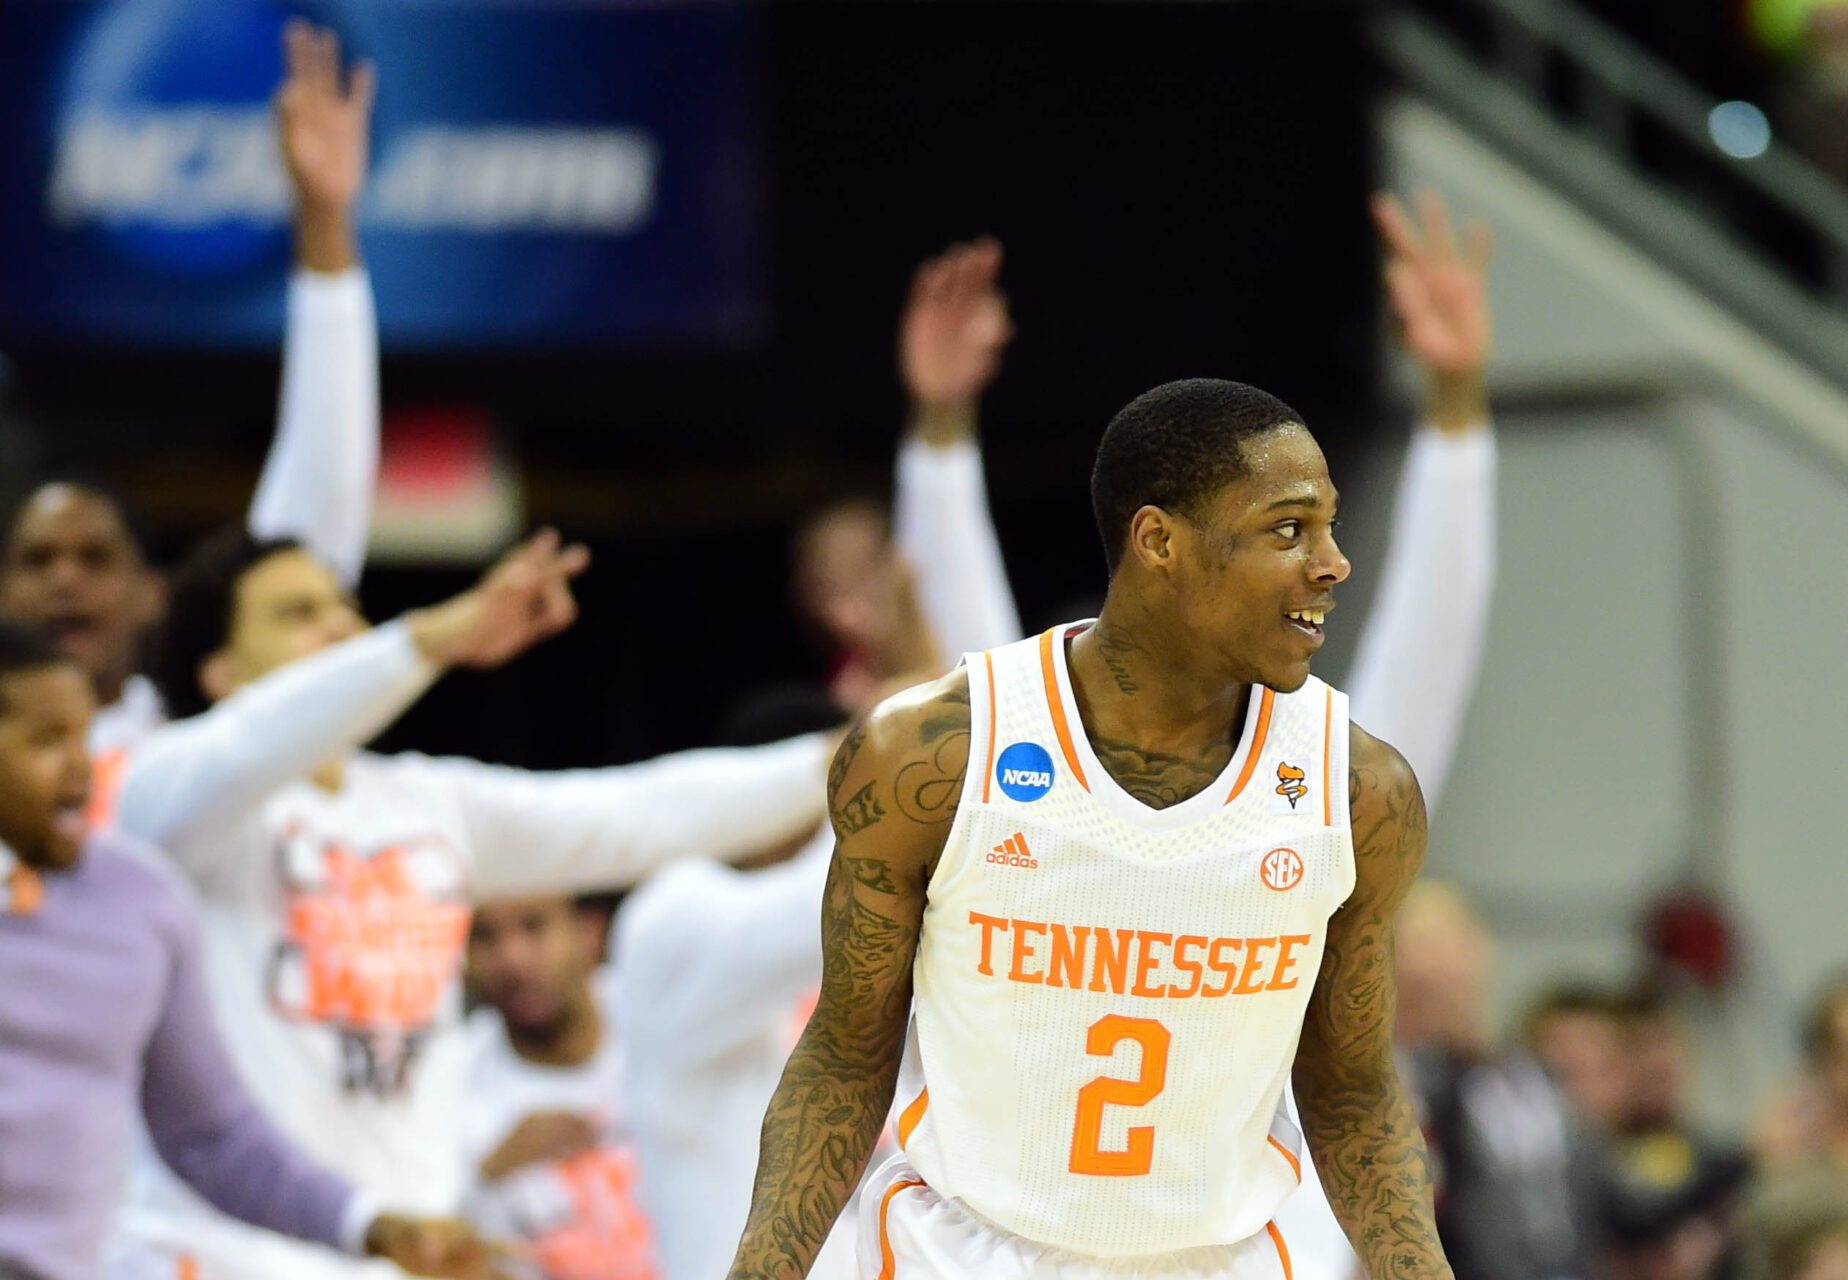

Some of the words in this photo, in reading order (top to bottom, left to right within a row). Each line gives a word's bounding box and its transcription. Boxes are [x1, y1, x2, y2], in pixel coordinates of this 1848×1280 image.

[1003, 769, 1051, 787] NCAA
[986, 852, 1038, 869] adidas
[1263, 849, 1302, 890] SEC
[968, 911, 1311, 999] TENNESSEE
[1069, 1013, 1171, 1177] 2
